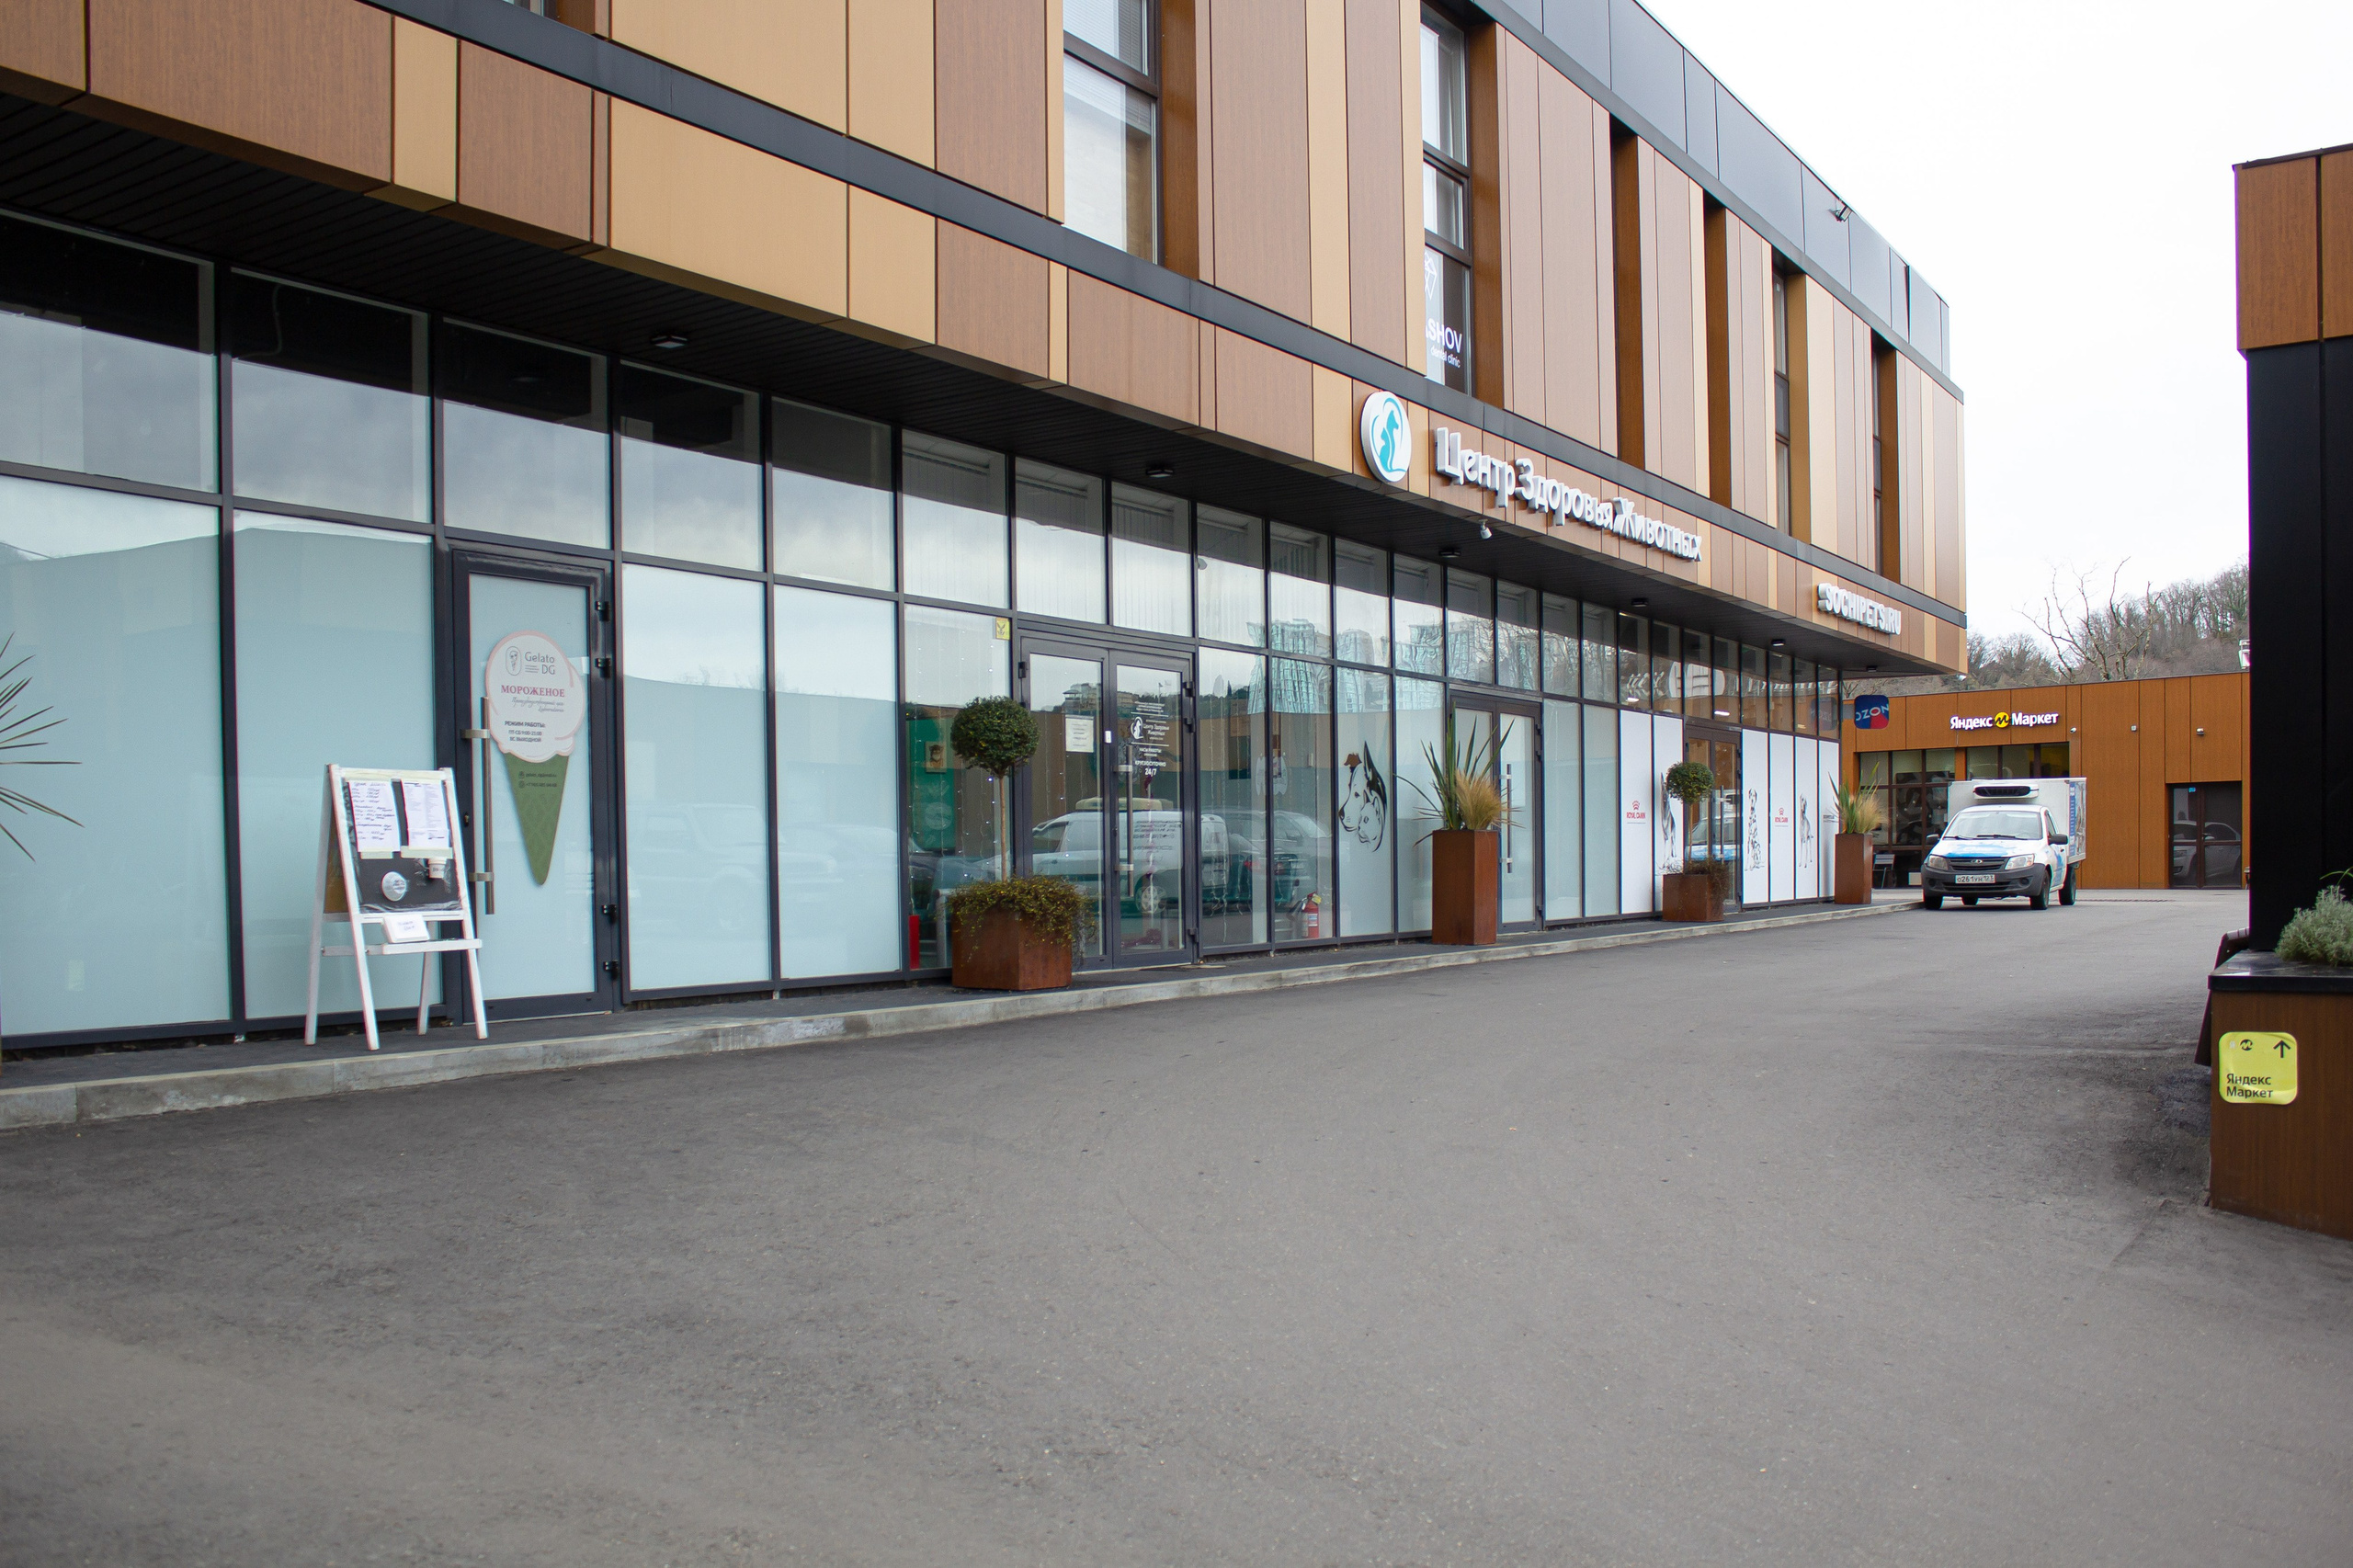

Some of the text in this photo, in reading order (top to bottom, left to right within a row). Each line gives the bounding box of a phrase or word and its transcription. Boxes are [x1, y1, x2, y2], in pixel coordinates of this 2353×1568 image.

[1426, 318, 1462, 354] SHOV
[1430, 345, 1461, 369] dental clinic
[1436, 427, 1703, 562] Центр Здоровья Животных
[1817, 583, 1902, 635] SOCHIPETS.RU
[525, 652, 555, 664] Gelato
[541, 665, 555, 675] DG
[501, 685, 565, 698] МОРОЖЕНОЕ
[1949, 712, 2059, 731] Яндекс Маркет
[1144, 768, 1157, 777] 24/7
[2226, 1074, 2272, 1085] Яндекс
[2226, 1086, 2273, 1098] Маркет
